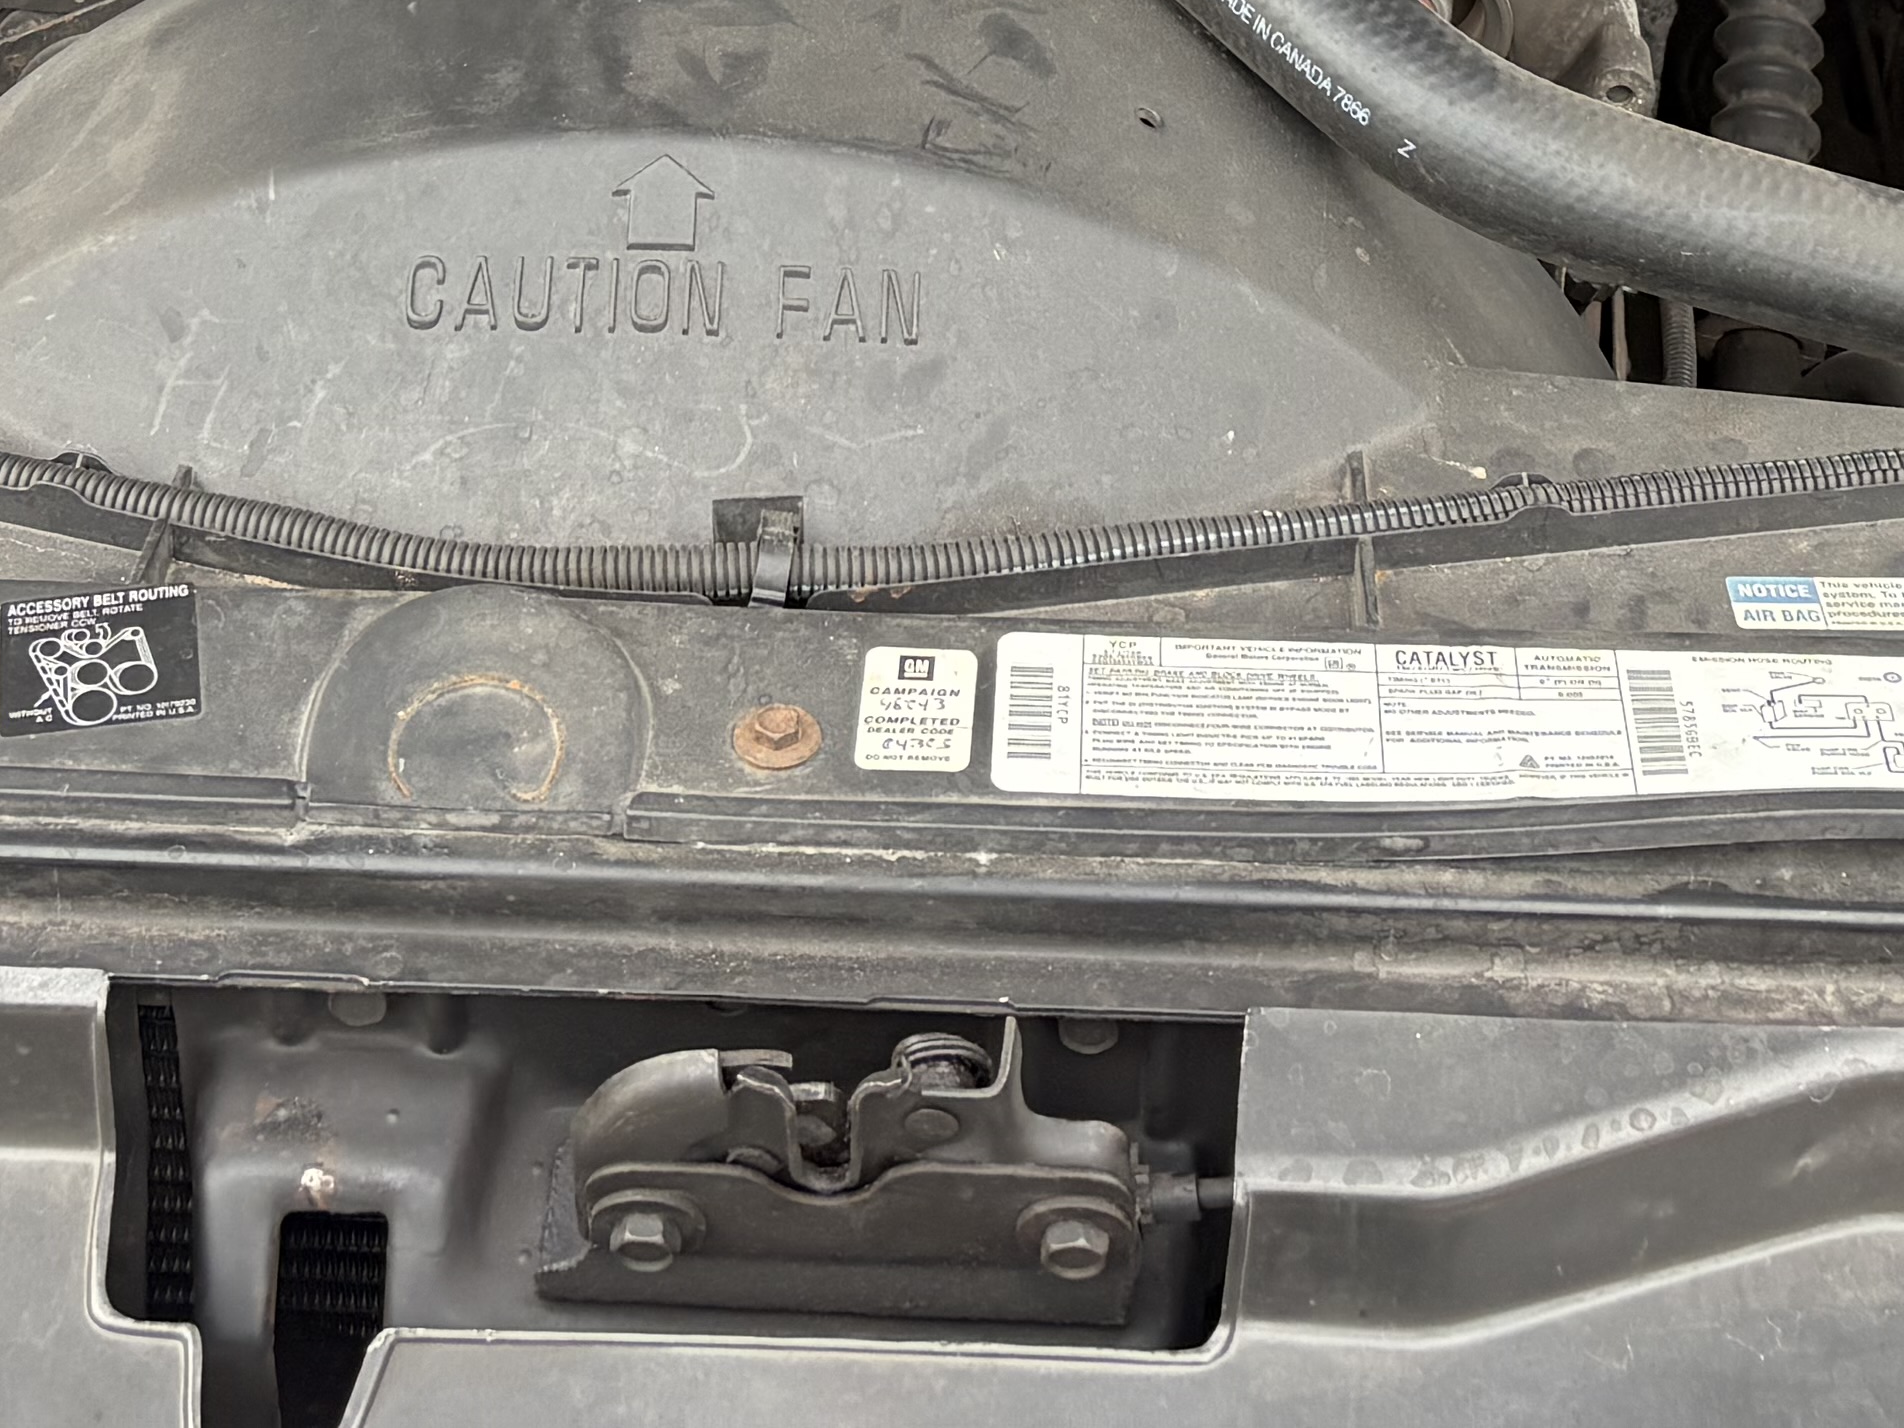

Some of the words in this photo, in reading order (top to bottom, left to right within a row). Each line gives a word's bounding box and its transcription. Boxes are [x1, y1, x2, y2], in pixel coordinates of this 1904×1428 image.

[1253, 13, 1272, 40] IN
[1270, 31, 1333, 97] CANADA
[1333, 86, 1372, 125] 7866
[406, 254, 725, 336] CAUTION
[776, 265, 921, 345] FAN
[1738, 583, 1810, 599] NOTICE
[1819, 581, 1848, 589] This
[8, 596, 89, 617] ACCESSORY
[93, 592, 125, 607] BELT
[129, 584, 189, 602] ROUTING
[102, 604, 143, 616] ROTATE
[1744, 609, 1777, 623] AIR
[1783, 609, 1821, 623] BAG
[8, 623, 68, 635] TENSIONER
[71, 618, 96, 628] CCW
[1109, 640, 1137, 649] YCP
[1396, 650, 1498, 666] CATALYST
[1534, 655, 1602, 663] AUTOMATIC
[870, 687, 960, 697] CAMPAIGN
[8, 707, 53, 719] WITHOUT
[864, 716, 960, 726] COMPLETED
